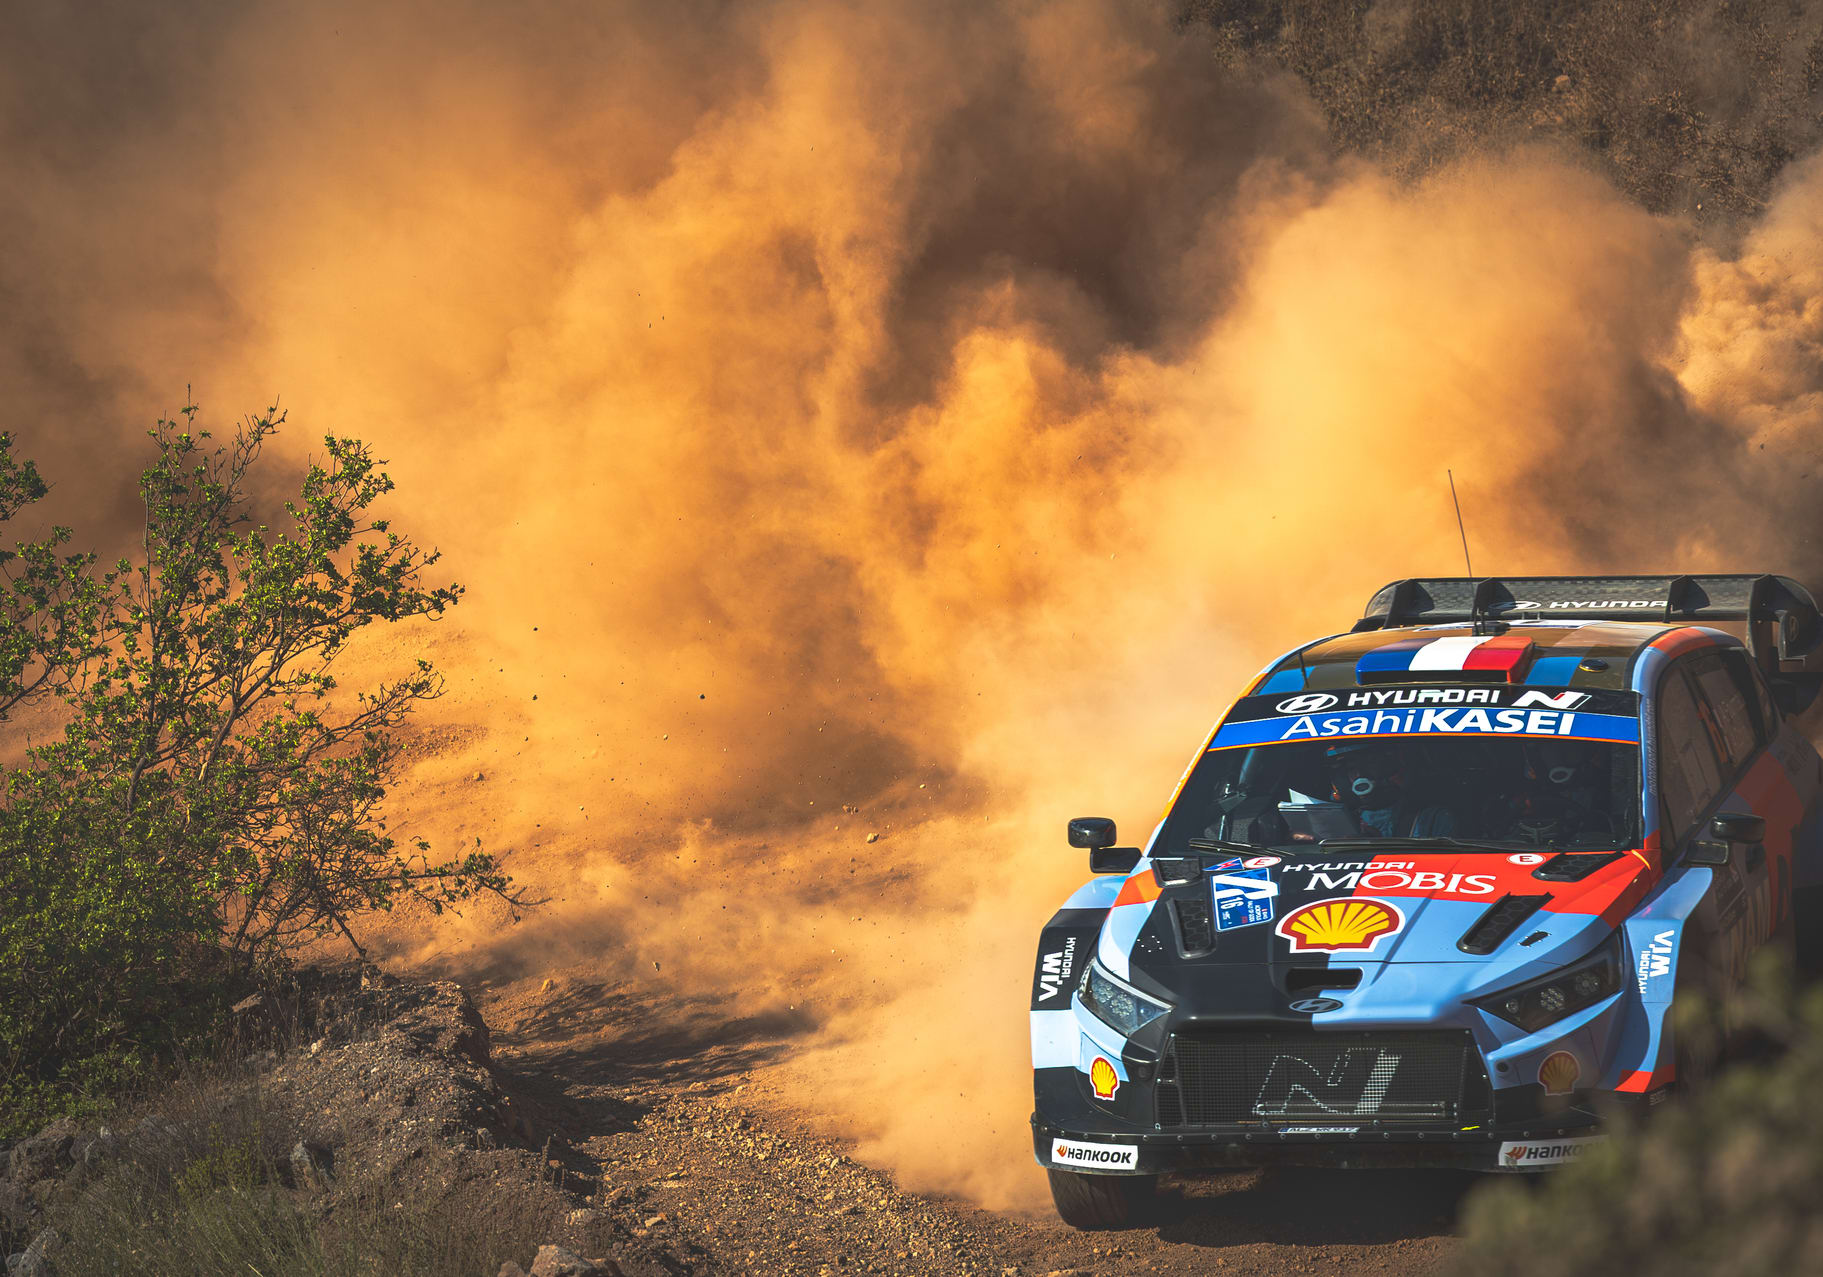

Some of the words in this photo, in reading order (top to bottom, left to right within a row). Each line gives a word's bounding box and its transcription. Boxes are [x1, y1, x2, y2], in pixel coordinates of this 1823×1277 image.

[1549, 600, 1668, 608] HYUNDA
[1348, 689, 1500, 707] HYUNDAI
[1283, 862, 1416, 872] HYUNDAI
[1518, 855, 1532, 863] E
[1303, 871, 1496, 896] MOBIS
[1061, 936, 1077, 978] HYUNDAI
[1638, 950, 1651, 994] HYUNDAI
